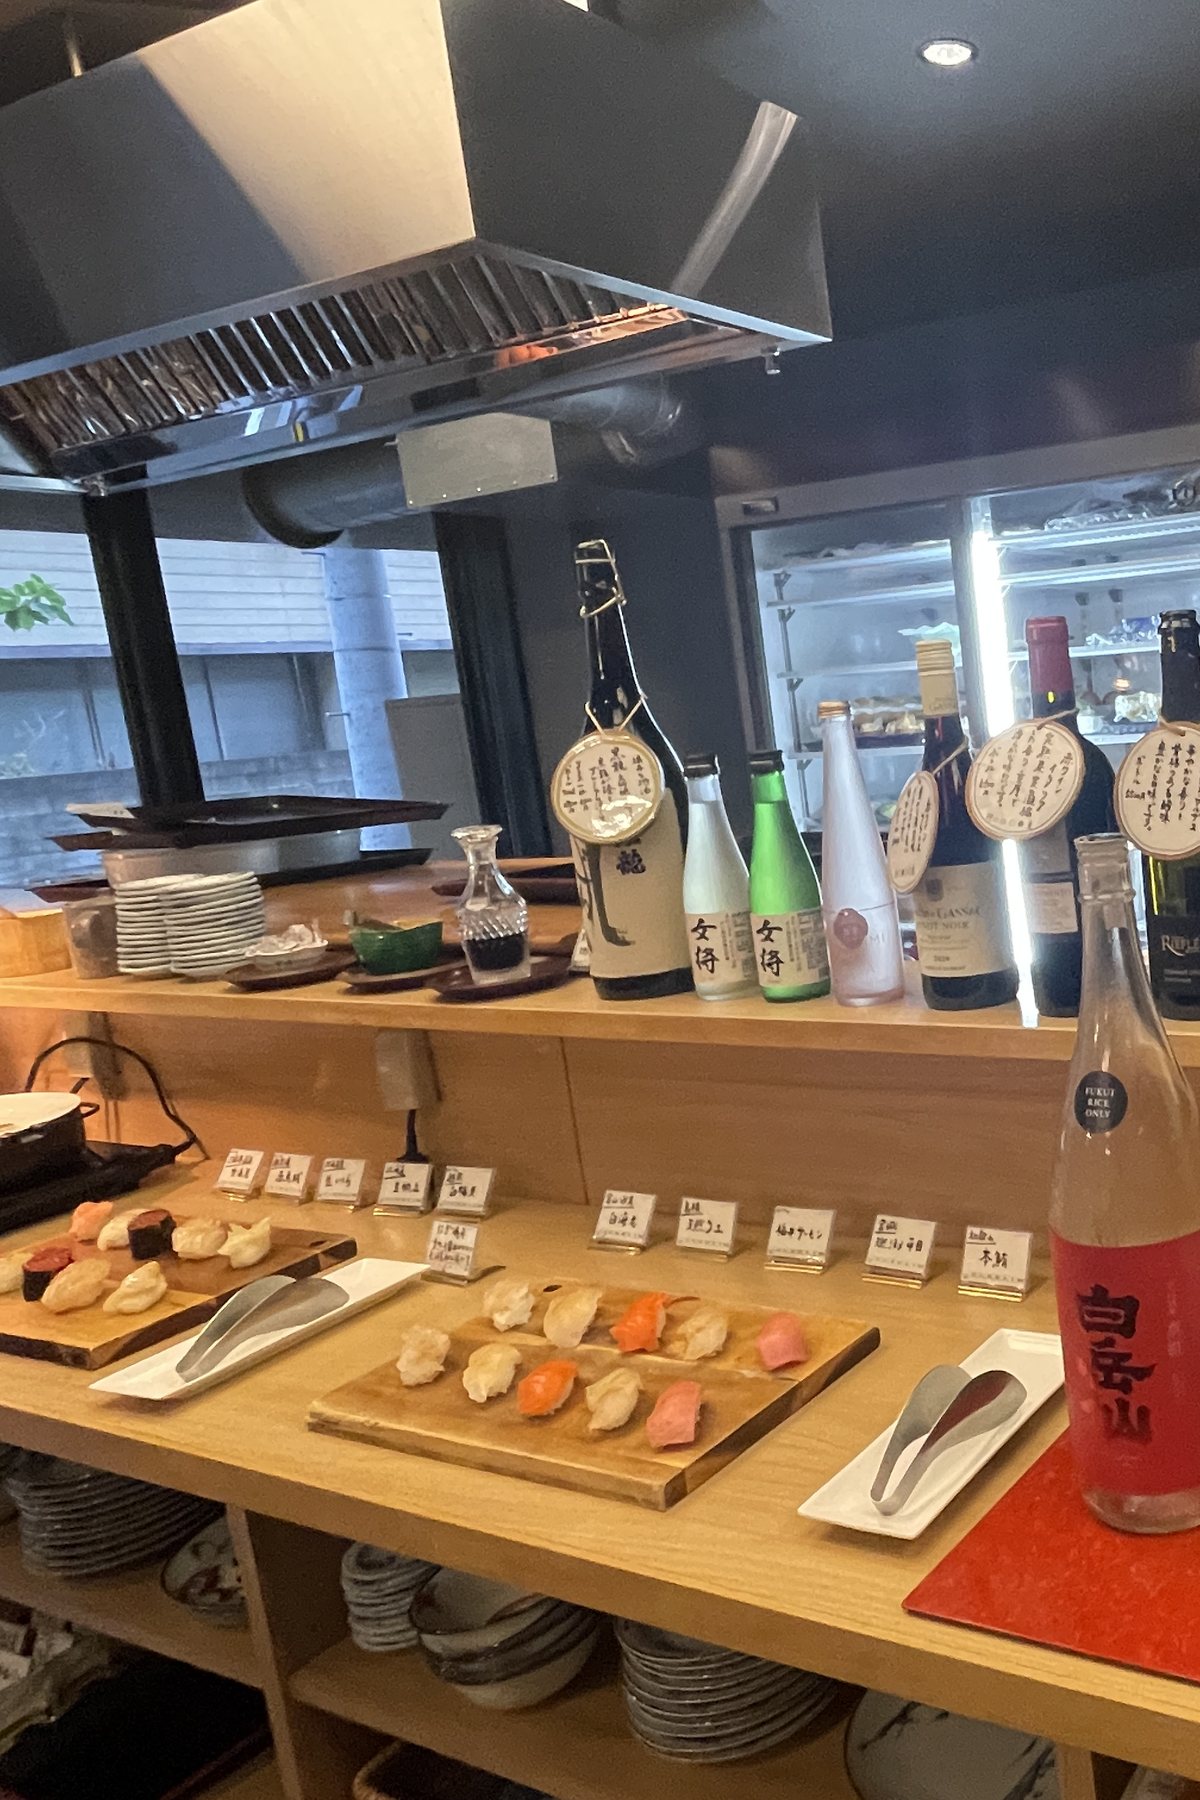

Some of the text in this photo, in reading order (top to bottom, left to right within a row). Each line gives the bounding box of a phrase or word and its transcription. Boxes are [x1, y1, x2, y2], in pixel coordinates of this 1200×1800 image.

[691, 918, 720, 974] 女将
[756, 919, 784, 977] 女将
[1085, 1087, 1115, 1097] FUKUI
[1087, 1098, 1109, 1108] RICE
[1085, 1109, 1111, 1118] ONLY
